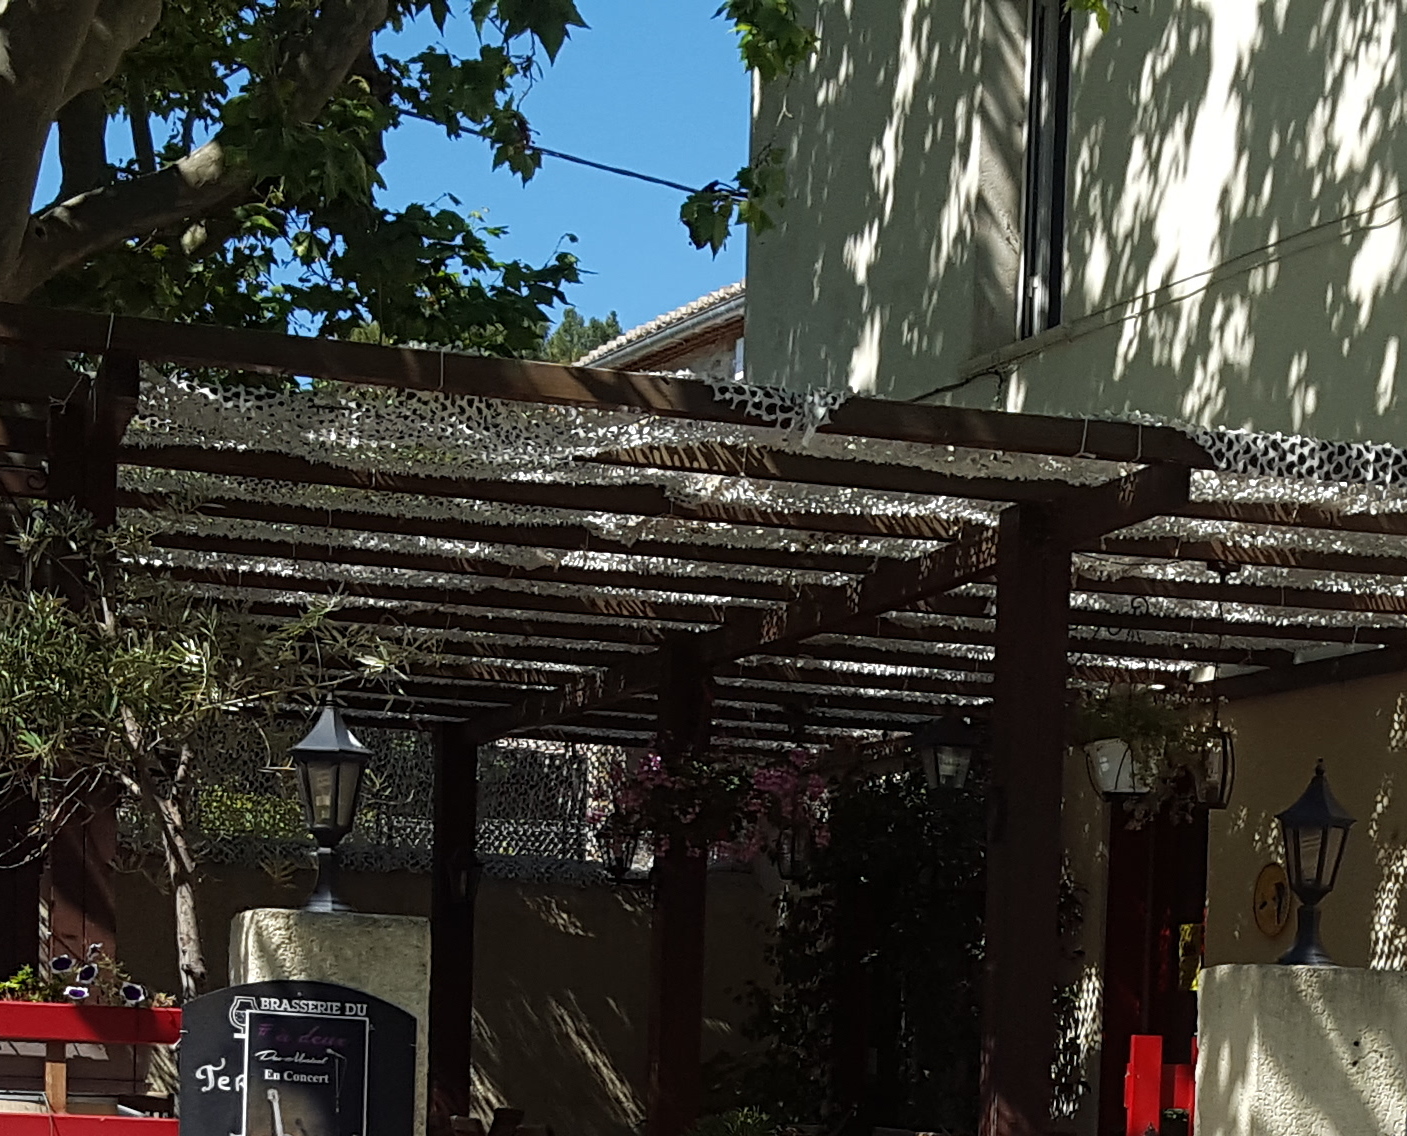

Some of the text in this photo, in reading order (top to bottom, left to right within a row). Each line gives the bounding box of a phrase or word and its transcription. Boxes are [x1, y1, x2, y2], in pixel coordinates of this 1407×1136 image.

[260, 997, 368, 1016] BRASSERIE DU
[264, 1068, 330, 1084] En Concert
